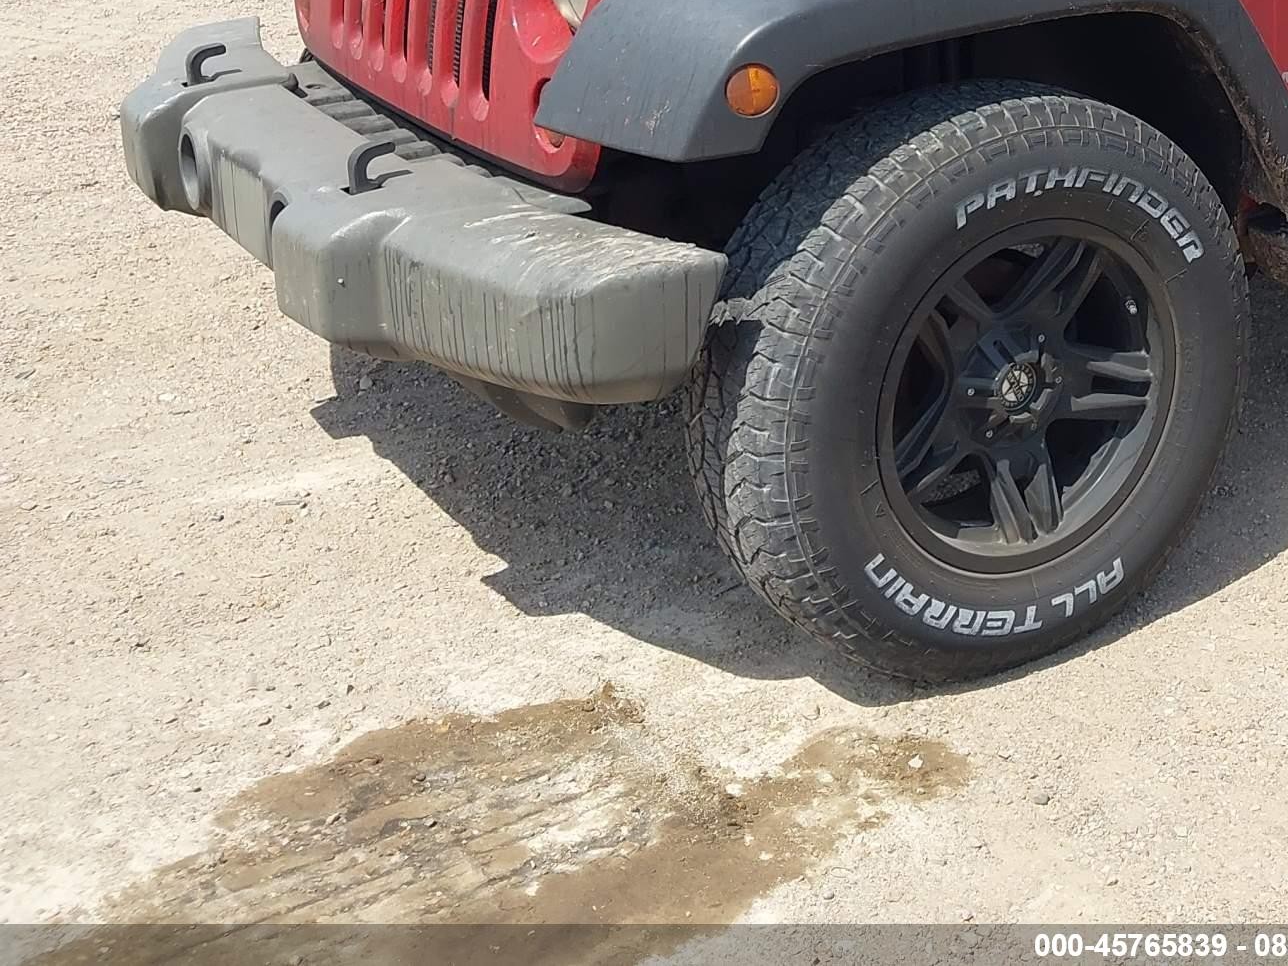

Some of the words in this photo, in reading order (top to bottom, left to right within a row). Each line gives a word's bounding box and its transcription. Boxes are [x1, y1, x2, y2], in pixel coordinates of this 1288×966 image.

[957, 166, 1205, 264] PATHFINDER
[864, 553, 1043, 636] TERRAIN
[1051, 557, 1125, 618] ALL
